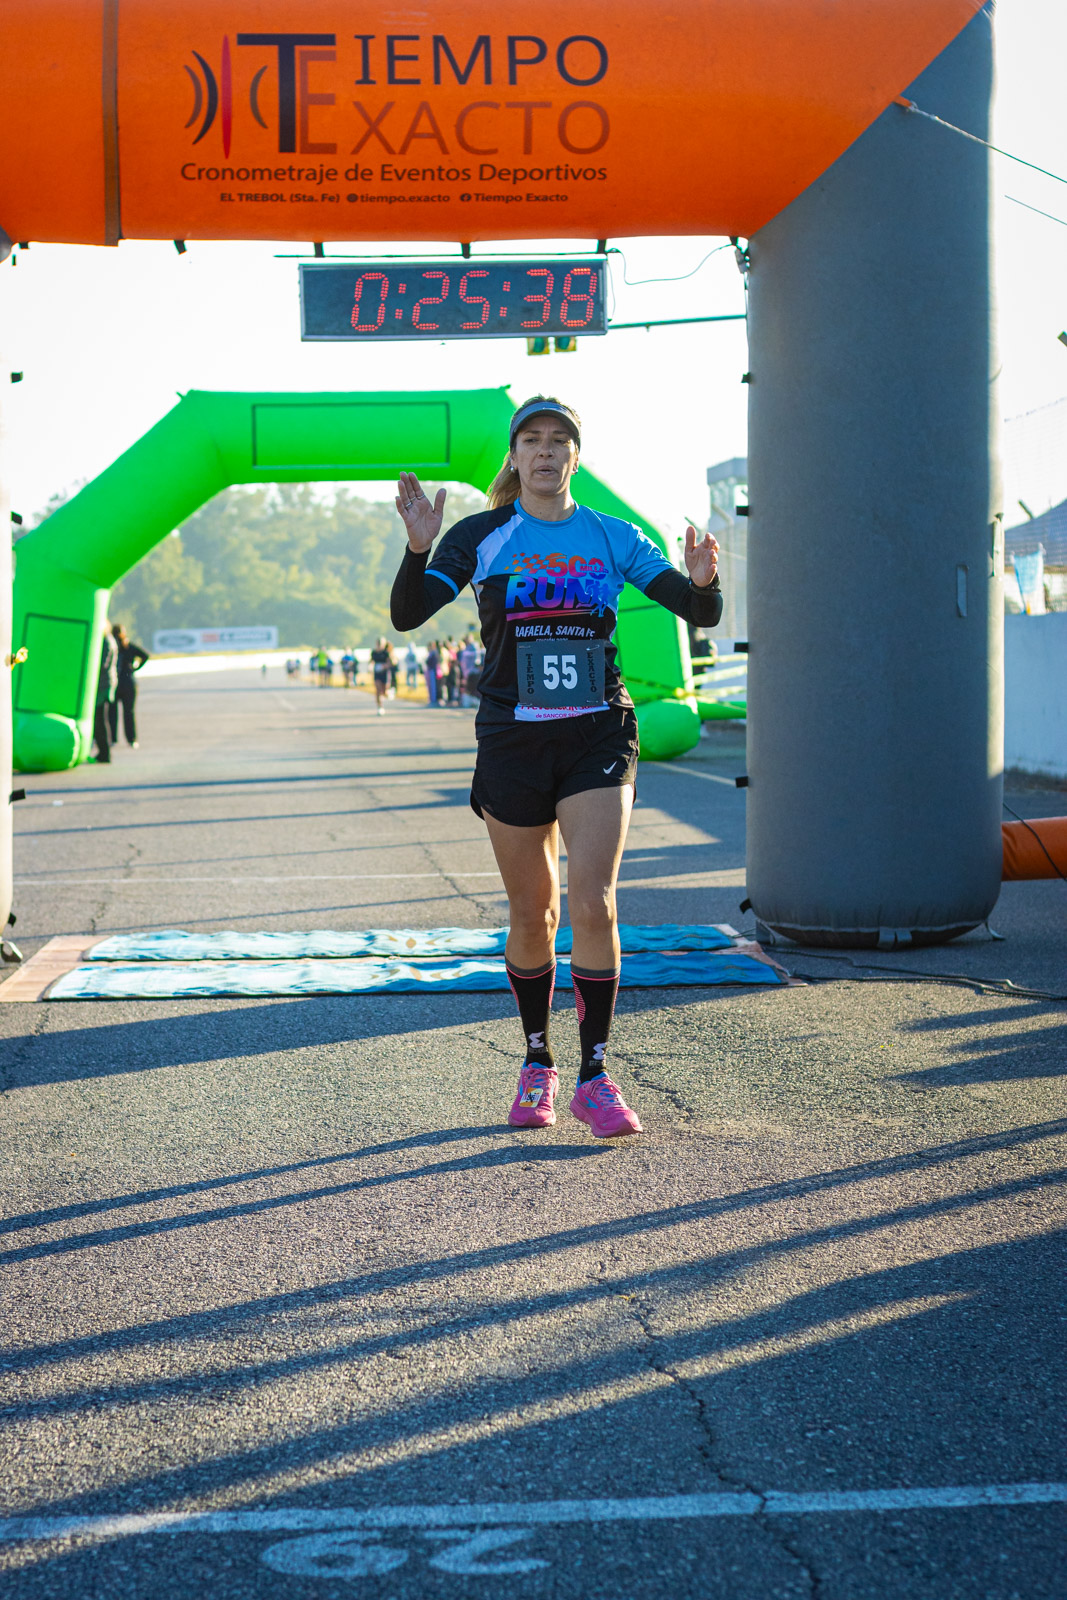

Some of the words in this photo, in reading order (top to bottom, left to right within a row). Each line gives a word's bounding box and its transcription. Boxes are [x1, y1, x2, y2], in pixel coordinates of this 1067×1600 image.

[180, 163, 338, 185] Cronometraje
[345, 163, 373, 181] de
[380, 164, 471, 181] Eventos
[479, 164, 608, 185] Deportivos
[220, 193, 235, 202] EL
[237, 193, 286, 202] TREBOL
[290, 193, 319, 203] (Sta.
[321, 193, 341, 203] Fe)
[474, 193, 523, 204] Tiempo
[526, 193, 569, 202] Exacto
[351, 268, 597, 332] 0:25:38
[545, 552, 606, 579] 500
[505, 575, 597, 609] RUN
[515, 625, 552, 637] RAFAELA,
[555, 625, 585, 637] SANTA
[525, 653, 535, 695] TIEMPO
[543, 655, 578, 690] 55
[587, 652, 597, 693] EXACTO
